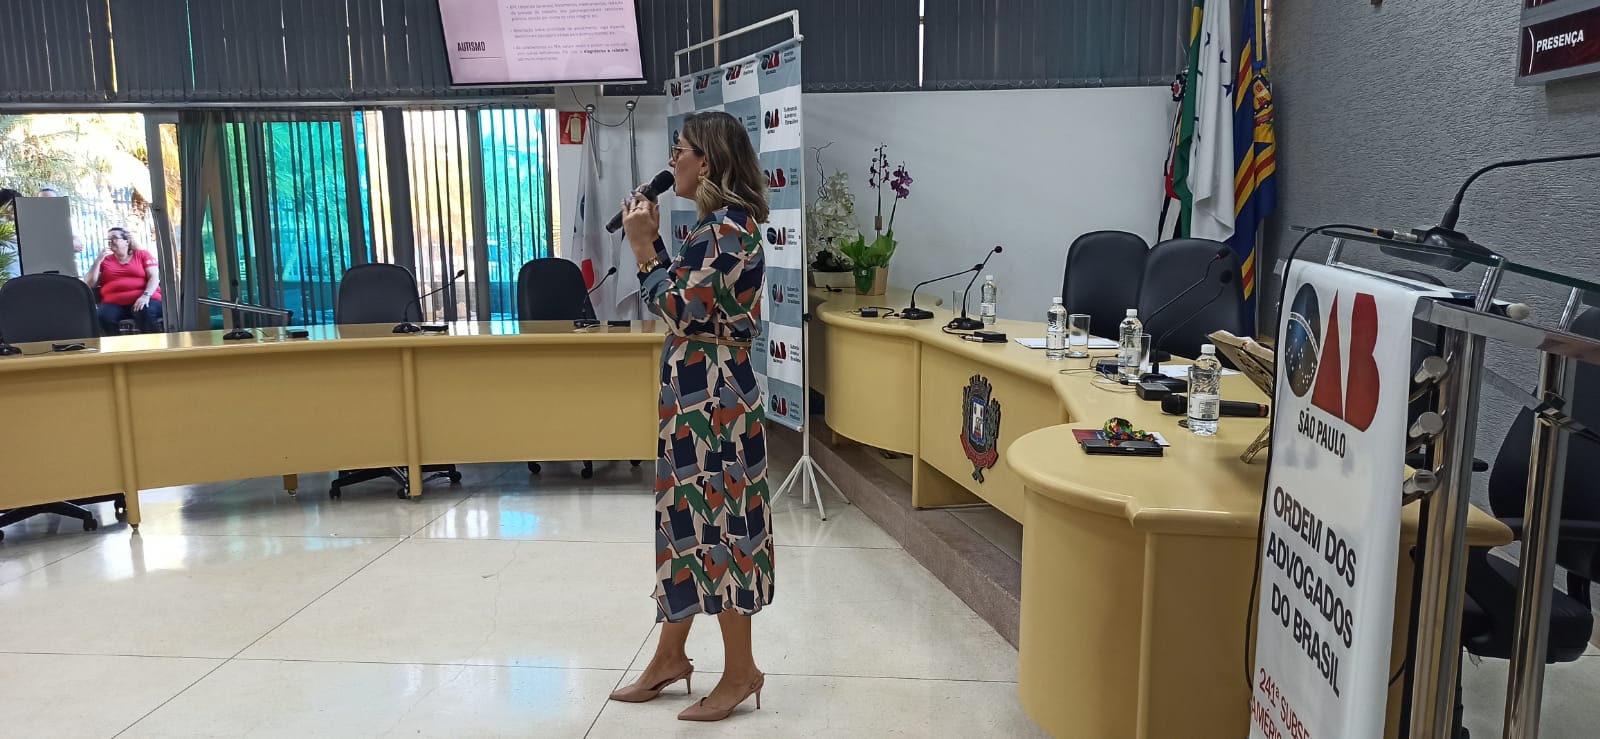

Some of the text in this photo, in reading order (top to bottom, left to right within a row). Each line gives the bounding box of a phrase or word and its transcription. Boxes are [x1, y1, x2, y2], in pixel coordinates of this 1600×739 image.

[457, 41, 486, 51] AUTISMO
[1536, 29, 1584, 52] PRESENÇA
[764, 108, 779, 129] OAB
[770, 340, 786, 360] OAB
[1285, 283, 1380, 432] OAB
[771, 395, 787, 416] OAB
[1297, 408, 1346, 459] SÃO PAULO
[1273, 486, 1357, 588] ORDEM DOS
[1266, 531, 1353, 649] ADVOGADOS
[1271, 582, 1340, 699] DO BRASIL
